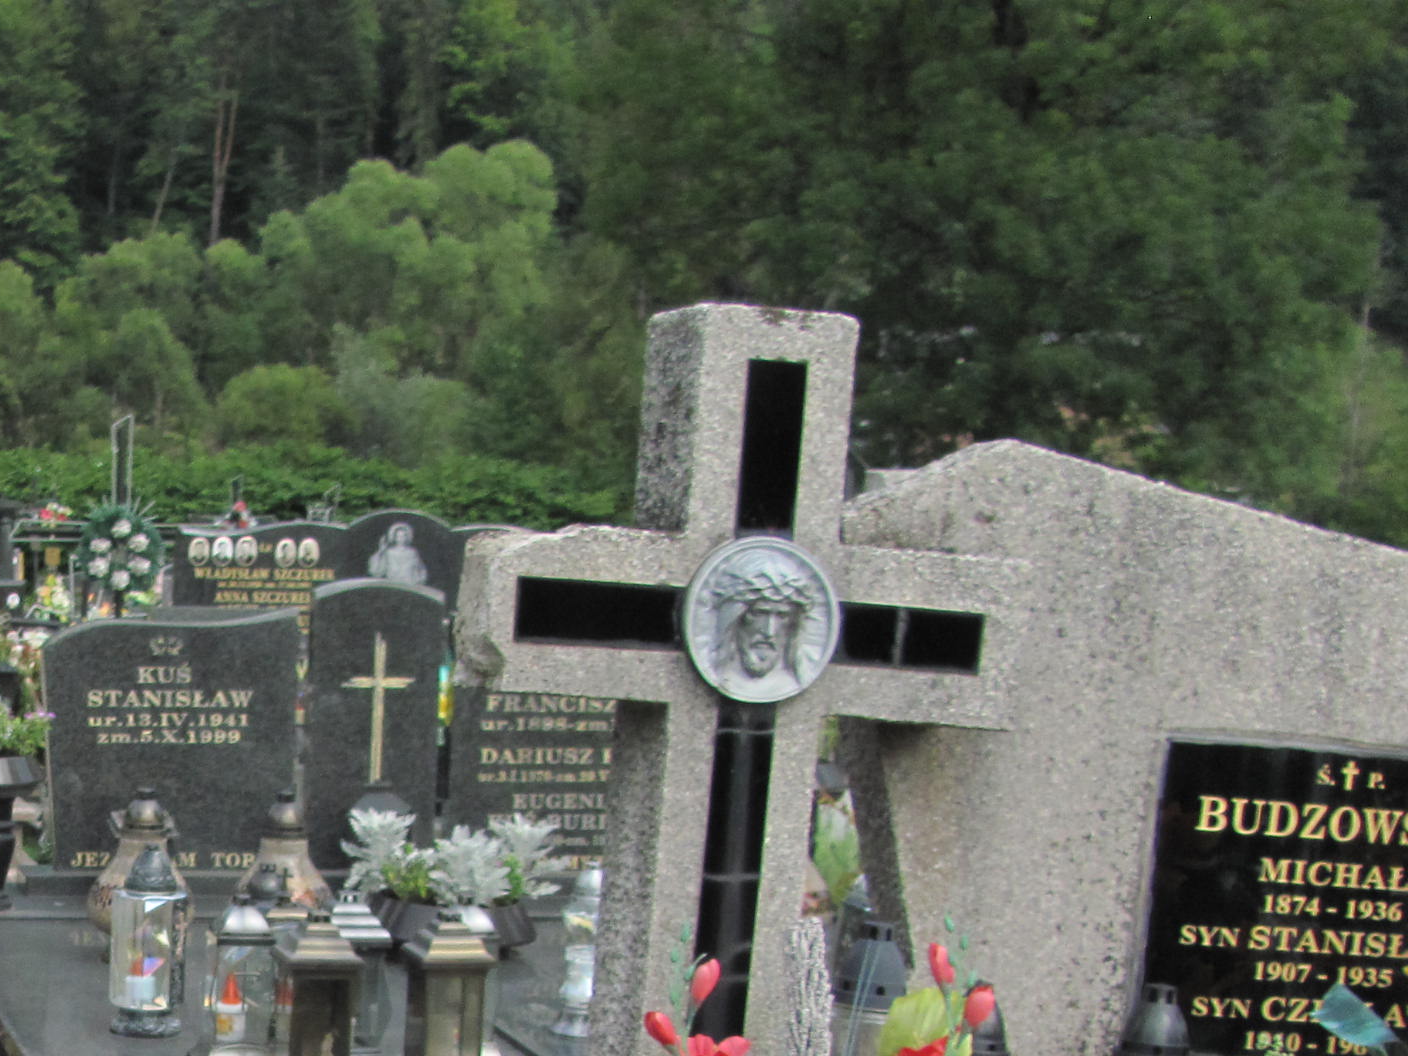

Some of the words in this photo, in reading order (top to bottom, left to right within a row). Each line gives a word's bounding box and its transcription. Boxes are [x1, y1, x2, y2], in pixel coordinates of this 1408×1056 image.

[137, 661, 192, 684] KUŚ
[86, 689, 254, 708] STANISŁAW
[479, 747, 594, 765] DARIUSZ
[1257, 857, 1408, 892] MICHAŁ
[1263, 893, 1321, 917] 1874
[1344, 899, 1404, 922] 1936
[1179, 924, 1240, 947] SYN
[1247, 925, 1408, 959] STANISŁ
[1253, 961, 1313, 984] 1907
[1336, 965, 1395, 989] 1935
[1191, 996, 1252, 1018] SYN
